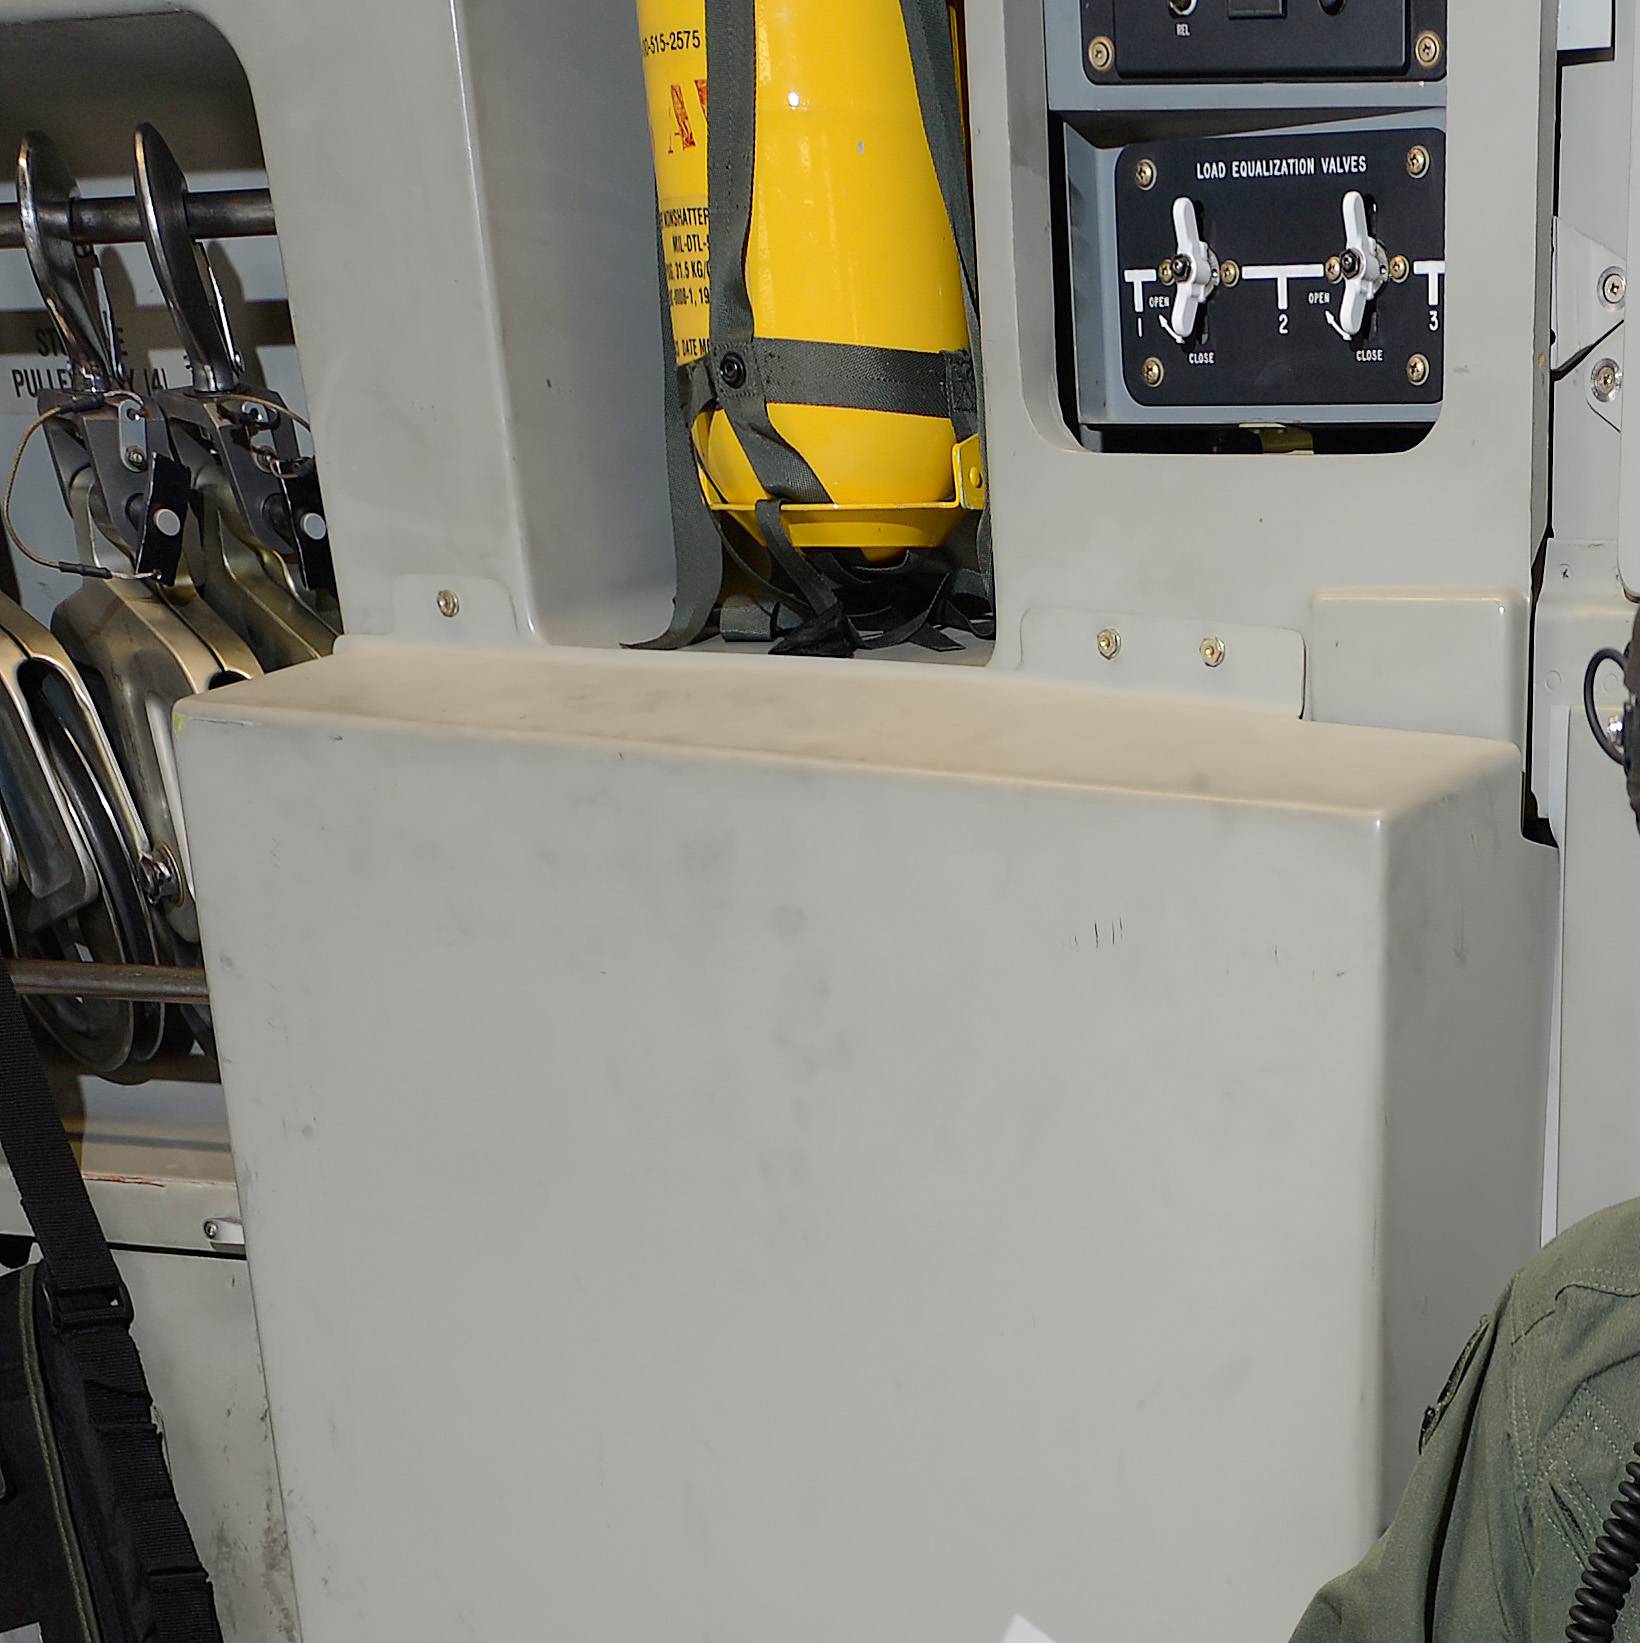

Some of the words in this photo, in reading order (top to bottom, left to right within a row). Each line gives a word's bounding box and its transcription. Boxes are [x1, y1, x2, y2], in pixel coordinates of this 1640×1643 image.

[1196, 161, 1227, 179] LOAD
[1232, 157, 1315, 178] EQUALIZATION
[1320, 156, 1367, 174] VALVES
[1149, 296, 1170, 308] OPEN
[1308, 292, 1330, 304] OPEN
[1278, 314, 1289, 334] 2
[1429, 310, 1439, 331] 3
[1189, 352, 1215, 365] CLOSE
[1356, 349, 1384, 362] CLOSE
